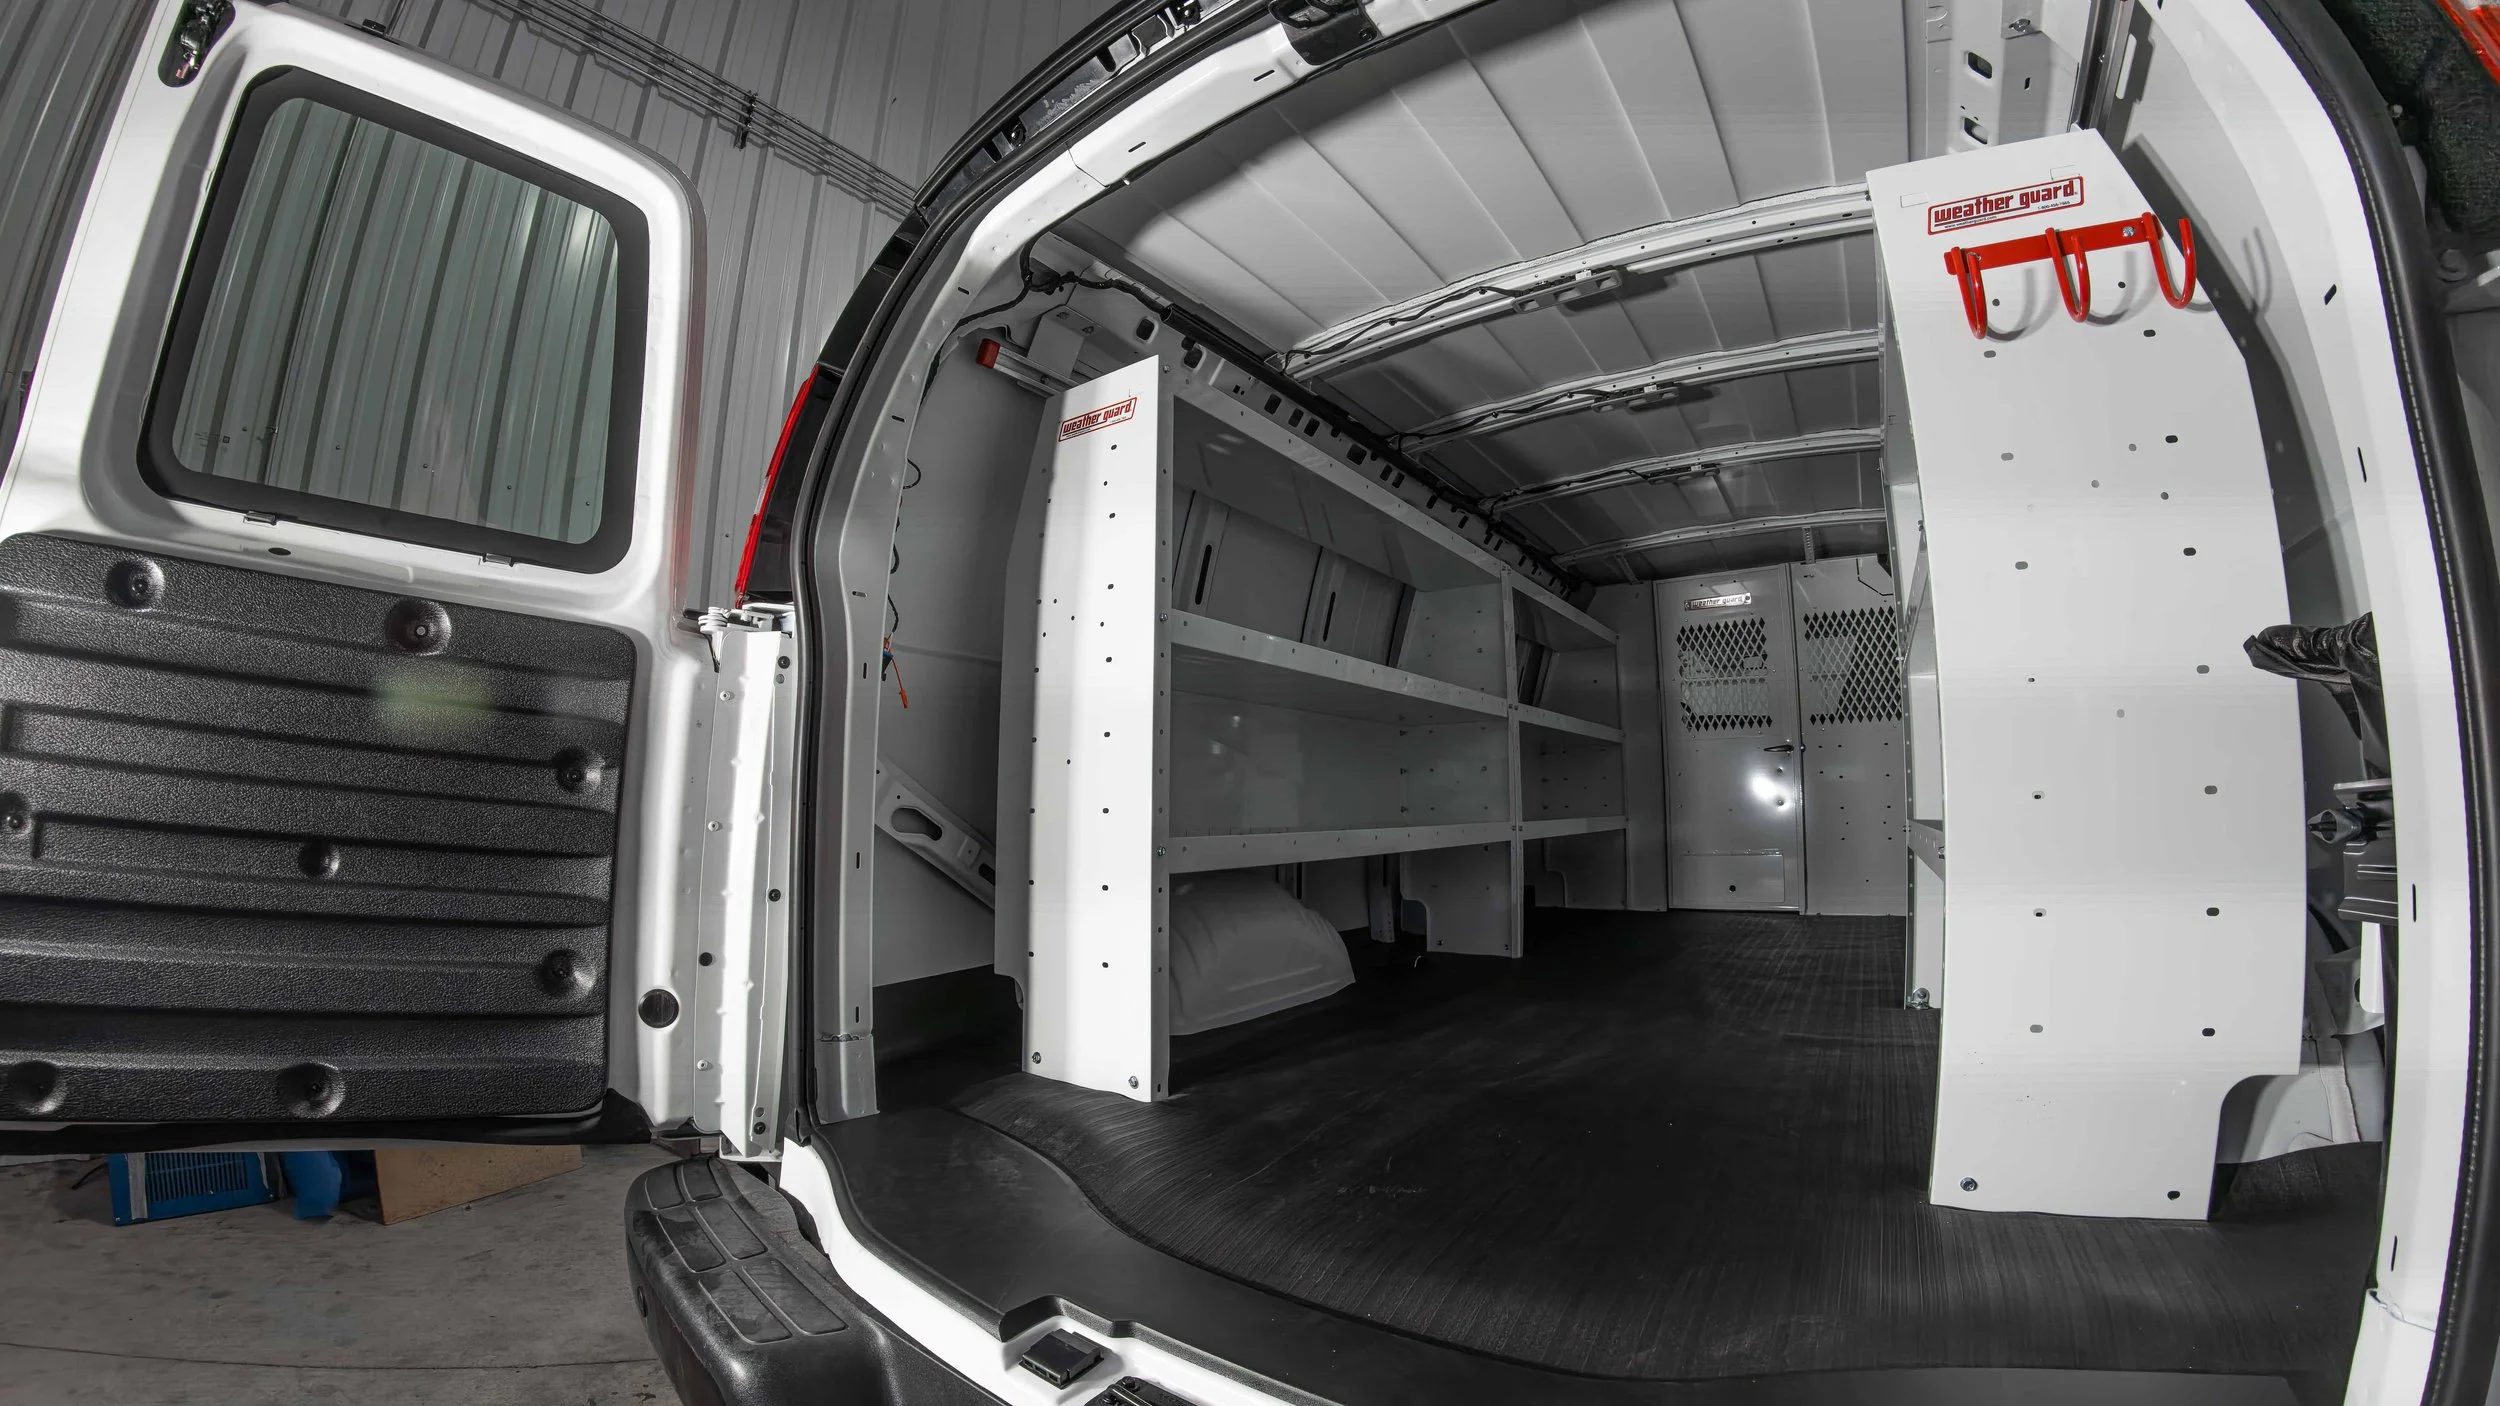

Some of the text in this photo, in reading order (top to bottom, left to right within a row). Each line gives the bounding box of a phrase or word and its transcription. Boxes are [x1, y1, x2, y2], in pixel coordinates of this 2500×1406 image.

[1934, 181, 2074, 222] weather guard
[1063, 413, 1101, 433] weather
[1103, 401, 1131, 422] guard
